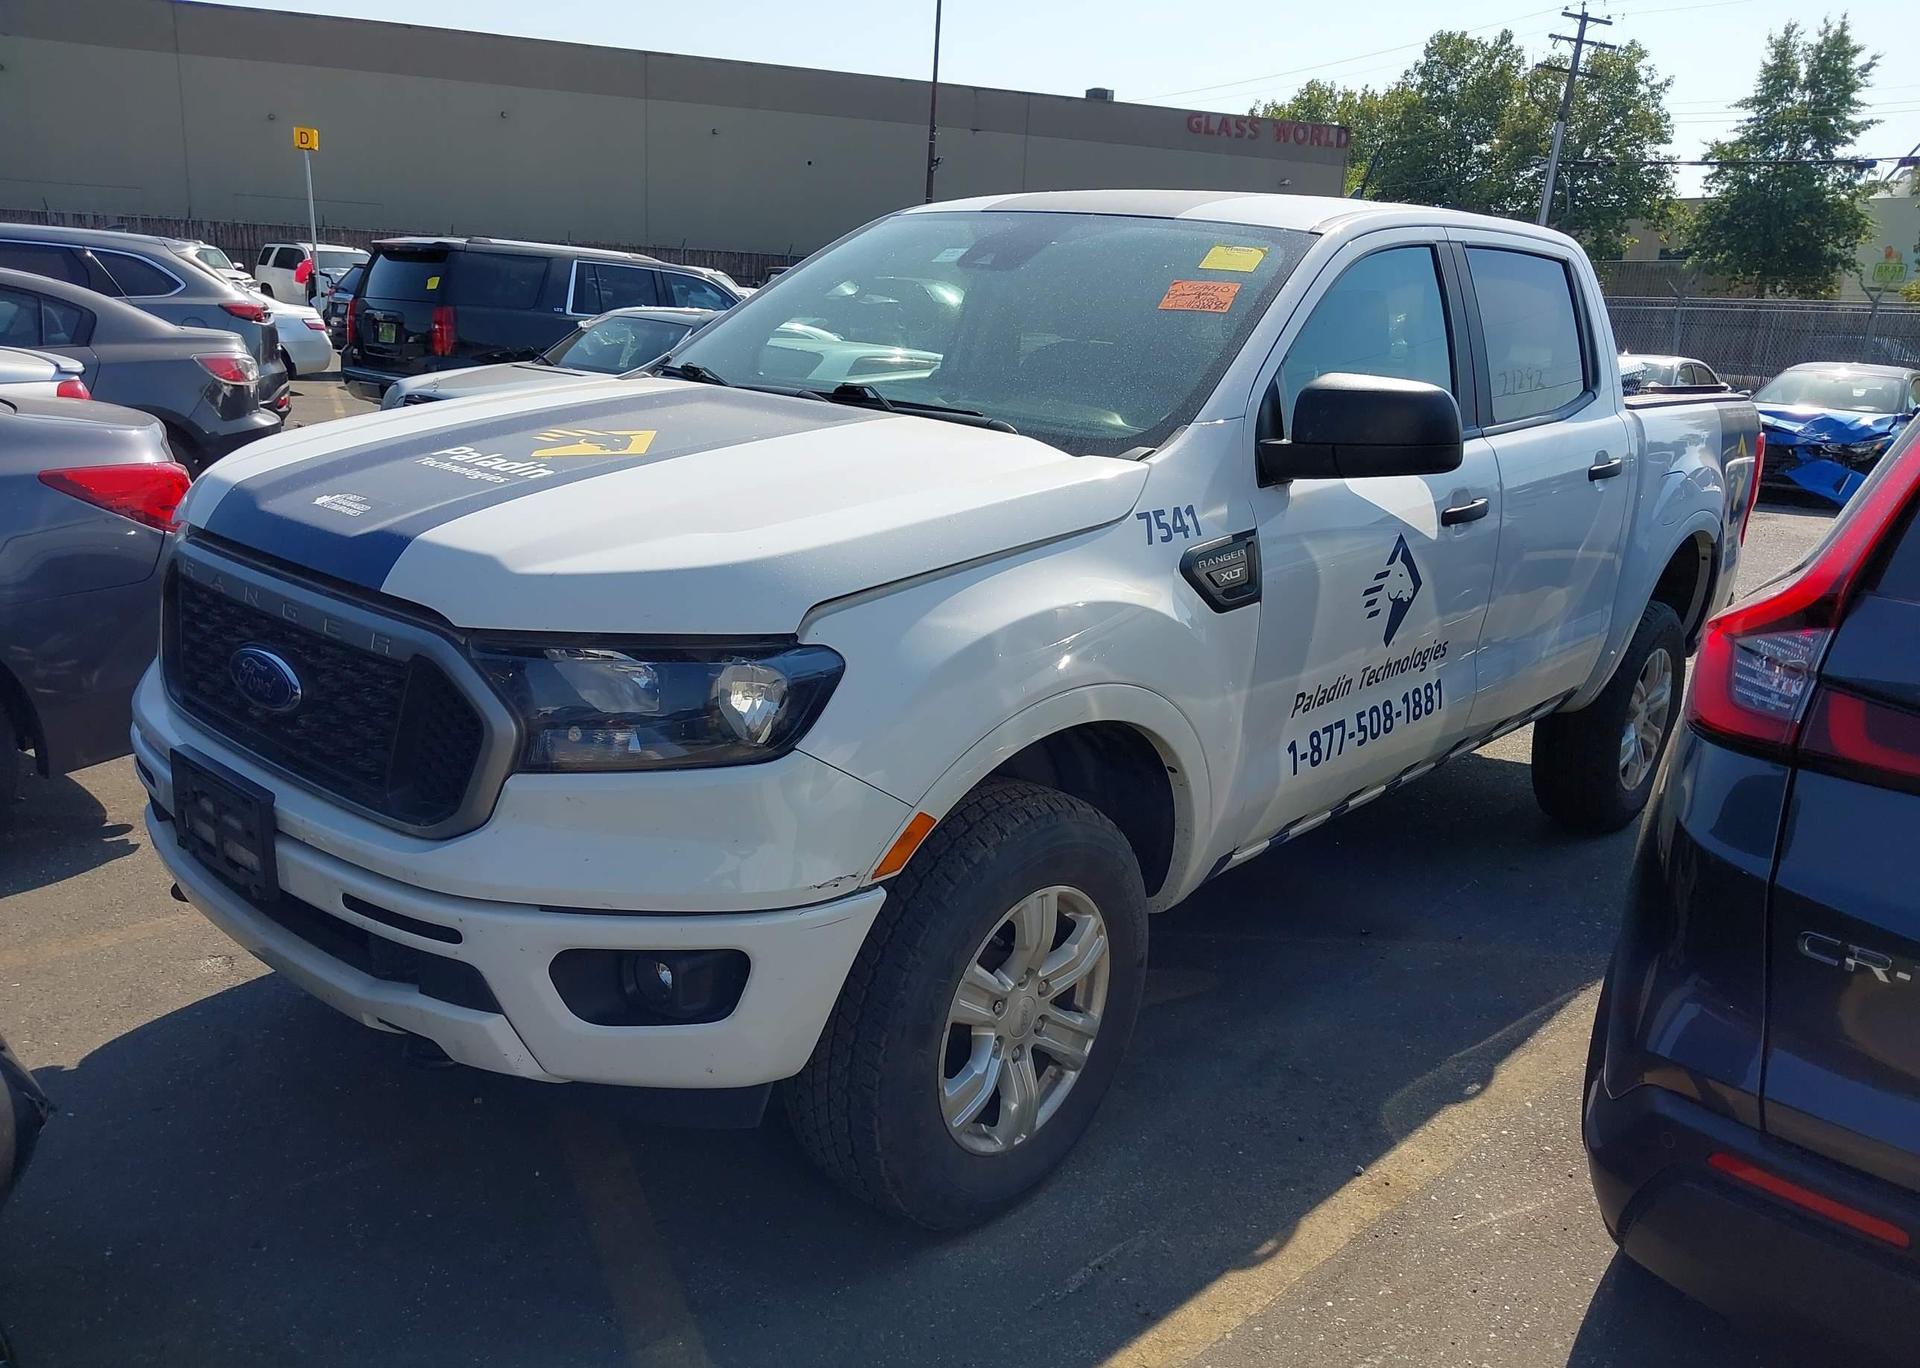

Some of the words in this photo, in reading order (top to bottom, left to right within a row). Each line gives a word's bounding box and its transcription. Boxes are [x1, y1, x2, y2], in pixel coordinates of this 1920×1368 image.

[299, 131, 310, 145] D
[1187, 111, 1262, 139] GLASS
[1272, 121, 1349, 148] WORLD
[415, 456, 510, 483] Technologies
[431, 446, 554, 479] Paladin
[1136, 504, 1202, 546] 7541
[1198, 548, 1247, 569] RANGER
[1220, 566, 1244, 583] XLT
[182, 559, 393, 656] RANGER
[1290, 675, 1353, 719] Paladin
[1358, 639, 1449, 691] Technologies
[1286, 678, 1444, 776] 1-877-508-1881
[1797, 930, 1920, 984] CR-
